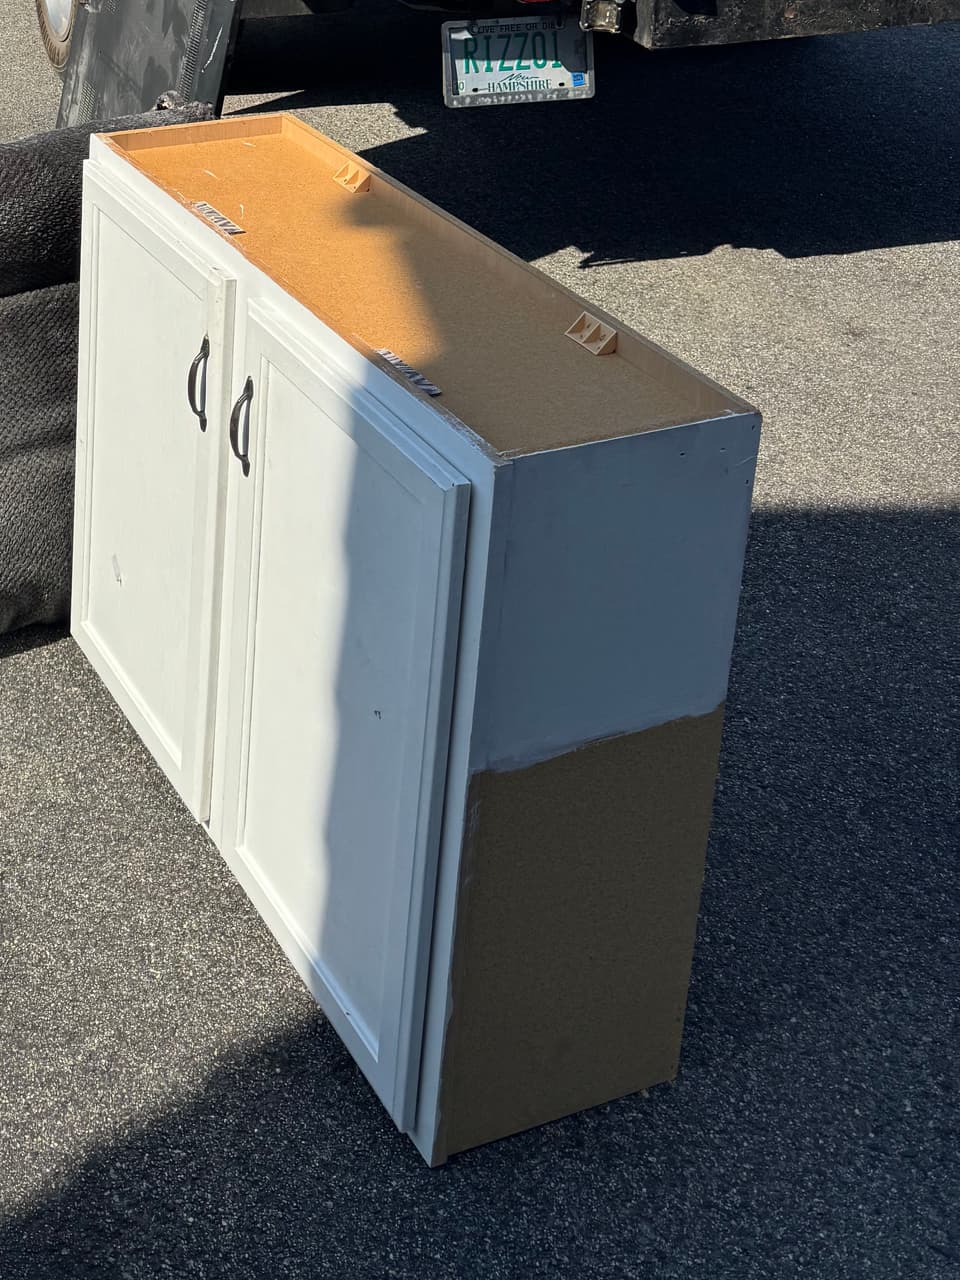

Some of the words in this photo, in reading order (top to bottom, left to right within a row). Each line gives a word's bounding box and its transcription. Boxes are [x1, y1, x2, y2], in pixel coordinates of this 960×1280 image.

[500, 24, 520, 33] FREE
[526, 23, 538, 31] OR
[487, 79, 553, 93] HAMPSHIRE
